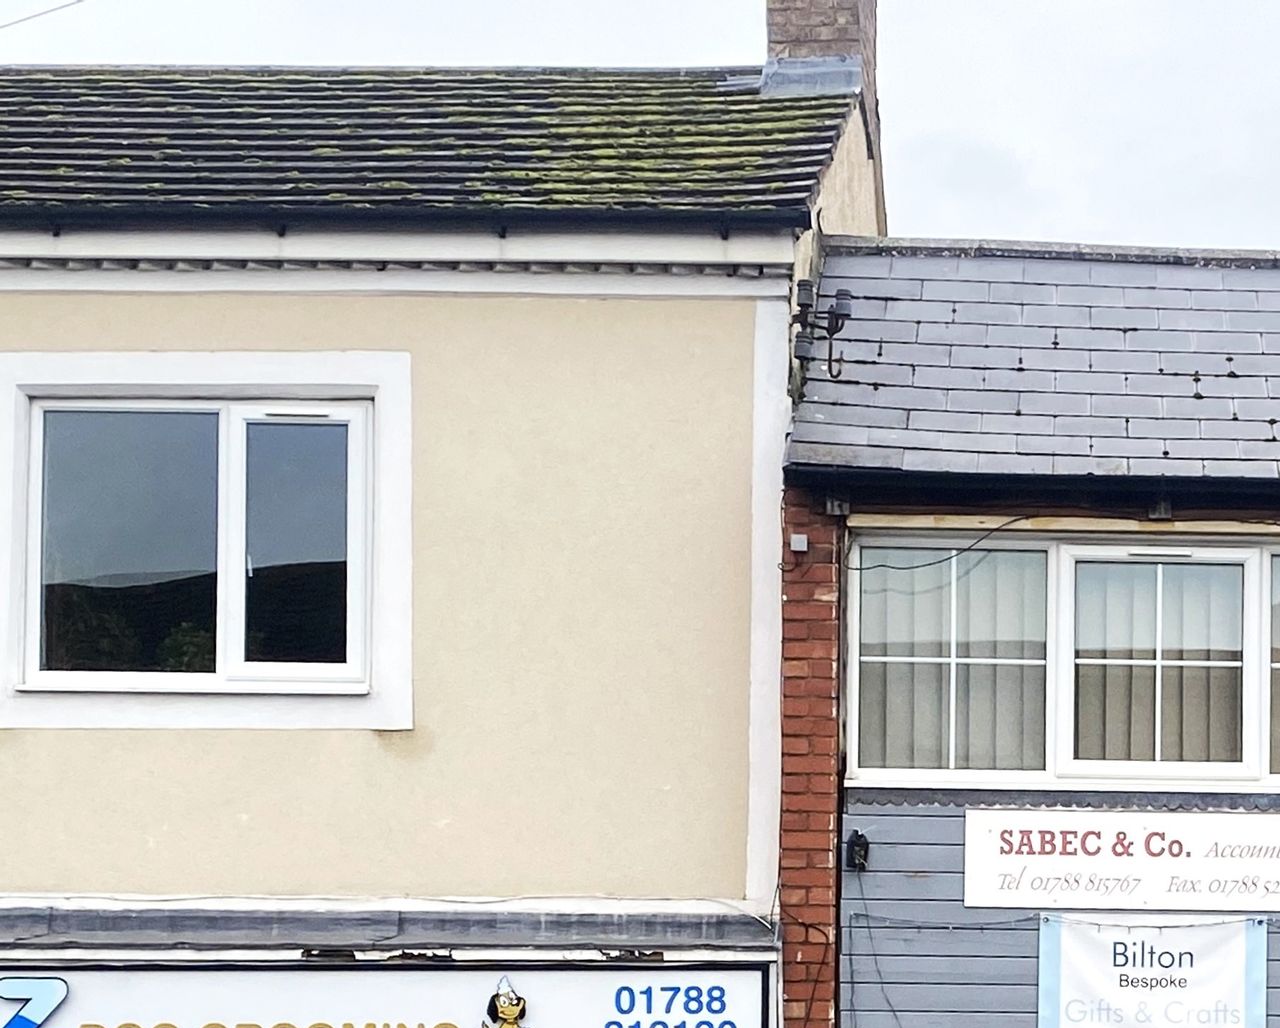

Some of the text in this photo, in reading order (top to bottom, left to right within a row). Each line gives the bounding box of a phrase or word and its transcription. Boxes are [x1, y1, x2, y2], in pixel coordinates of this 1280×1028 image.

[1000, 829, 1102, 857] SABEC
[1111, 831, 1134, 857] &
[1144, 831, 1192, 858] Co.
[998, 865, 1028, 891] Tel
[1030, 872, 1083, 895] 01788
[1084, 872, 1142, 897] 815767
[1208, 875, 1261, 899] 01788
[1112, 940, 1195, 969] Bilton
[1119, 973, 1188, 991] Bespoke
[614, 985, 727, 1015] 01788
[1064, 998, 1241, 1025] Gifts & Crafts
